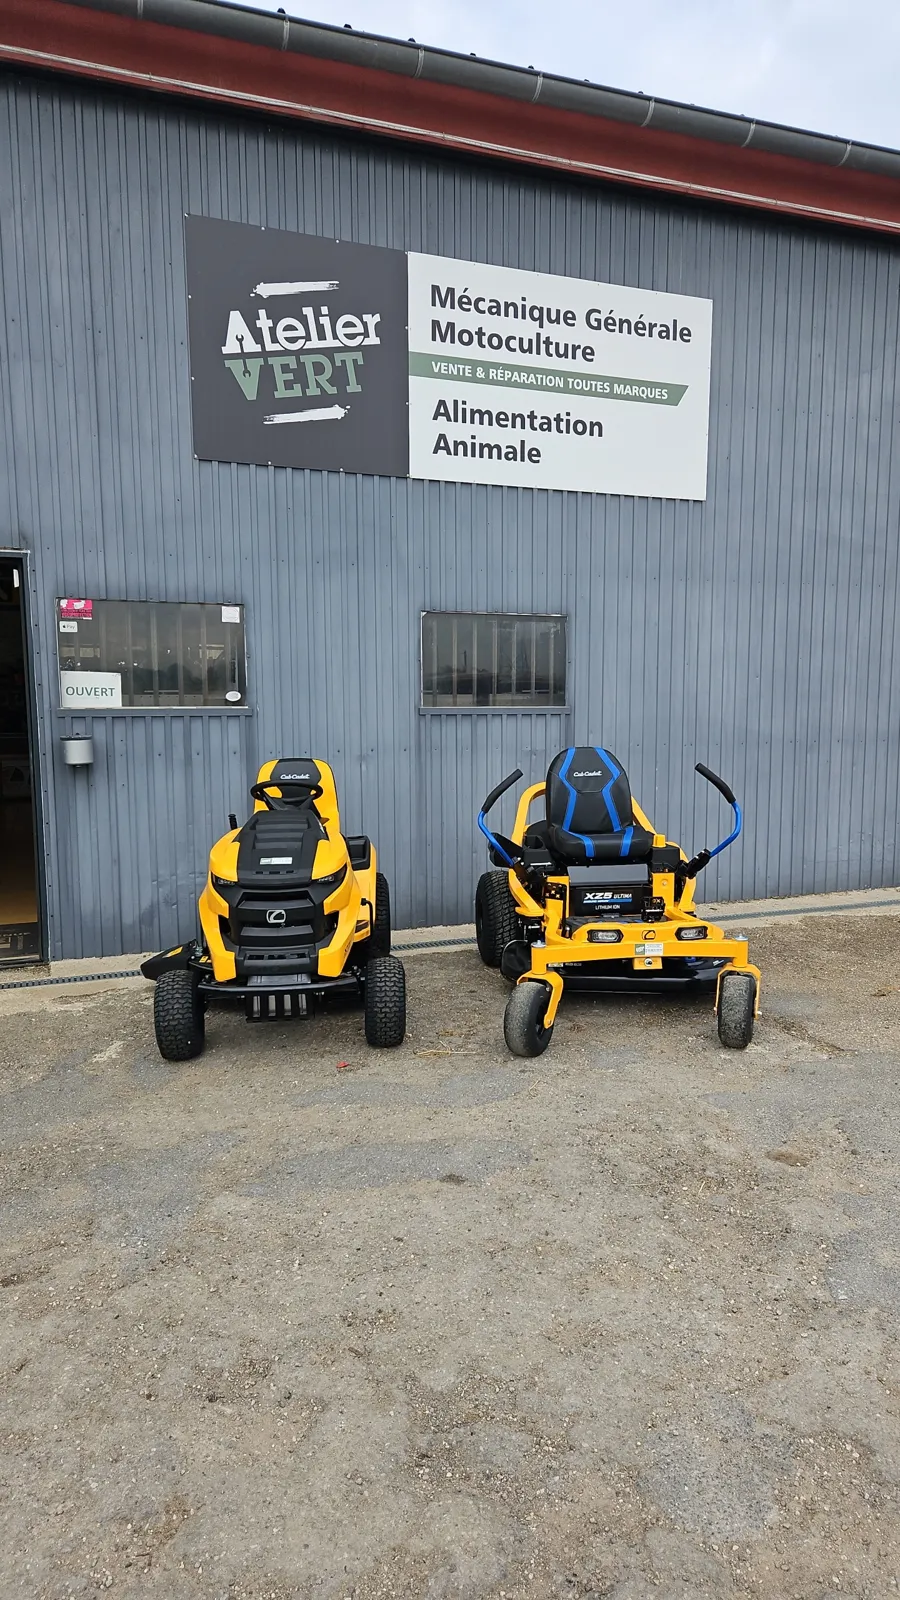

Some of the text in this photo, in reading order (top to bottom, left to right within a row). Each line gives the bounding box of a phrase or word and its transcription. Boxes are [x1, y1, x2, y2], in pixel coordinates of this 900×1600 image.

[221, 306, 381, 354] Atelier
[430, 284, 692, 343] Mécanique Générale
[430, 319, 596, 362] Motoculture
[224, 351, 364, 400] VERT
[431, 361, 668, 400] VENTE & RÉPARATION TOUTES MARQUES
[432, 399, 604, 438] Alimentation
[432, 433, 542, 464] Animale
[65, 686, 116, 697] OUVERT
[583, 892, 613, 900] XZ5
